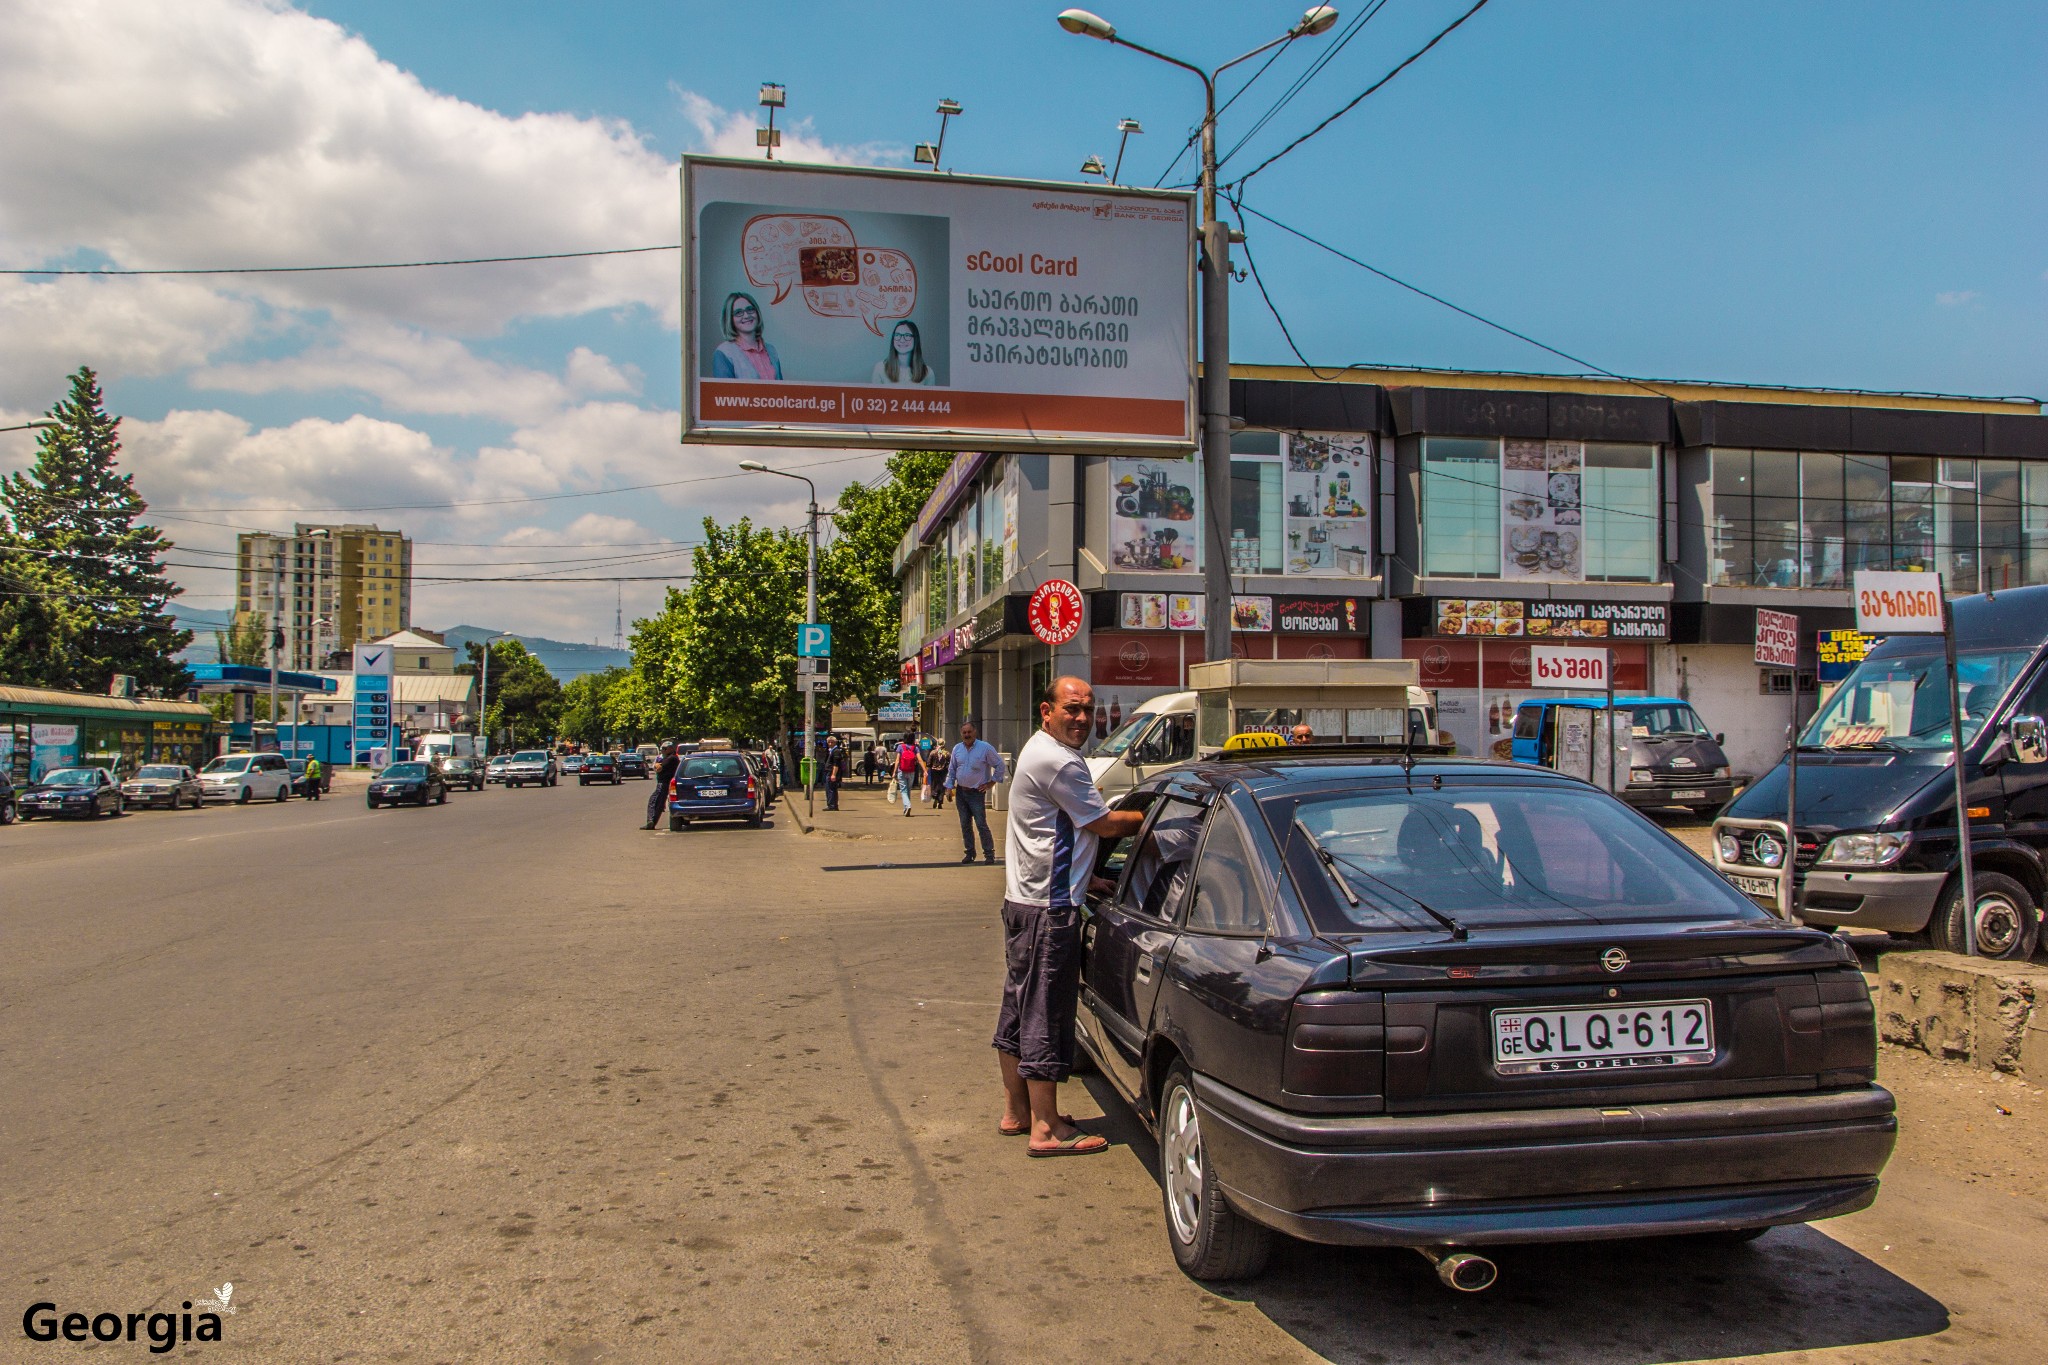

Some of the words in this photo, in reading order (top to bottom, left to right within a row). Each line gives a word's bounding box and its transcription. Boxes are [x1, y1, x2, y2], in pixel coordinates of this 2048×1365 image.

[967, 251, 1023, 273] sCool
[1031, 254, 1077, 276] Card
[968, 288, 1051, 312] საერთო
[1060, 293, 1138, 317] ბარათი
[968, 315, 1129, 342] მრავალმხრივი
[967, 342, 1128, 369] უპირატესობით
[715, 396, 836, 413] www.scoolcard.ge
[851, 399, 864, 413] (0
[866, 399, 887, 414] 32)
[890, 400, 898, 412] 2
[902, 400, 925, 413] 444
[928, 401, 951, 414] 444
[1532, 604, 1585, 618] საოჯახო
[1591, 605, 1666, 620] სამზარეულო
[1861, 590, 1937, 617] ვაზიანი
[1281, 616, 1339, 631] ტორტები
[1613, 622, 1666, 637] საცხობი
[1758, 610, 1796, 632] თელეთი
[804, 627, 825, 653] P
[1756, 628, 1796, 648] კოდა
[1756, 645, 1796, 665] მუხათი
[1537, 657, 1603, 680] ხაშმი
[1236, 737, 1279, 749] TAXI
[1502, 1037, 1523, 1054] GE
[1524, 1009, 1705, 1053] QLQ-612
[1577, 1058, 1638, 1069] OPEL
